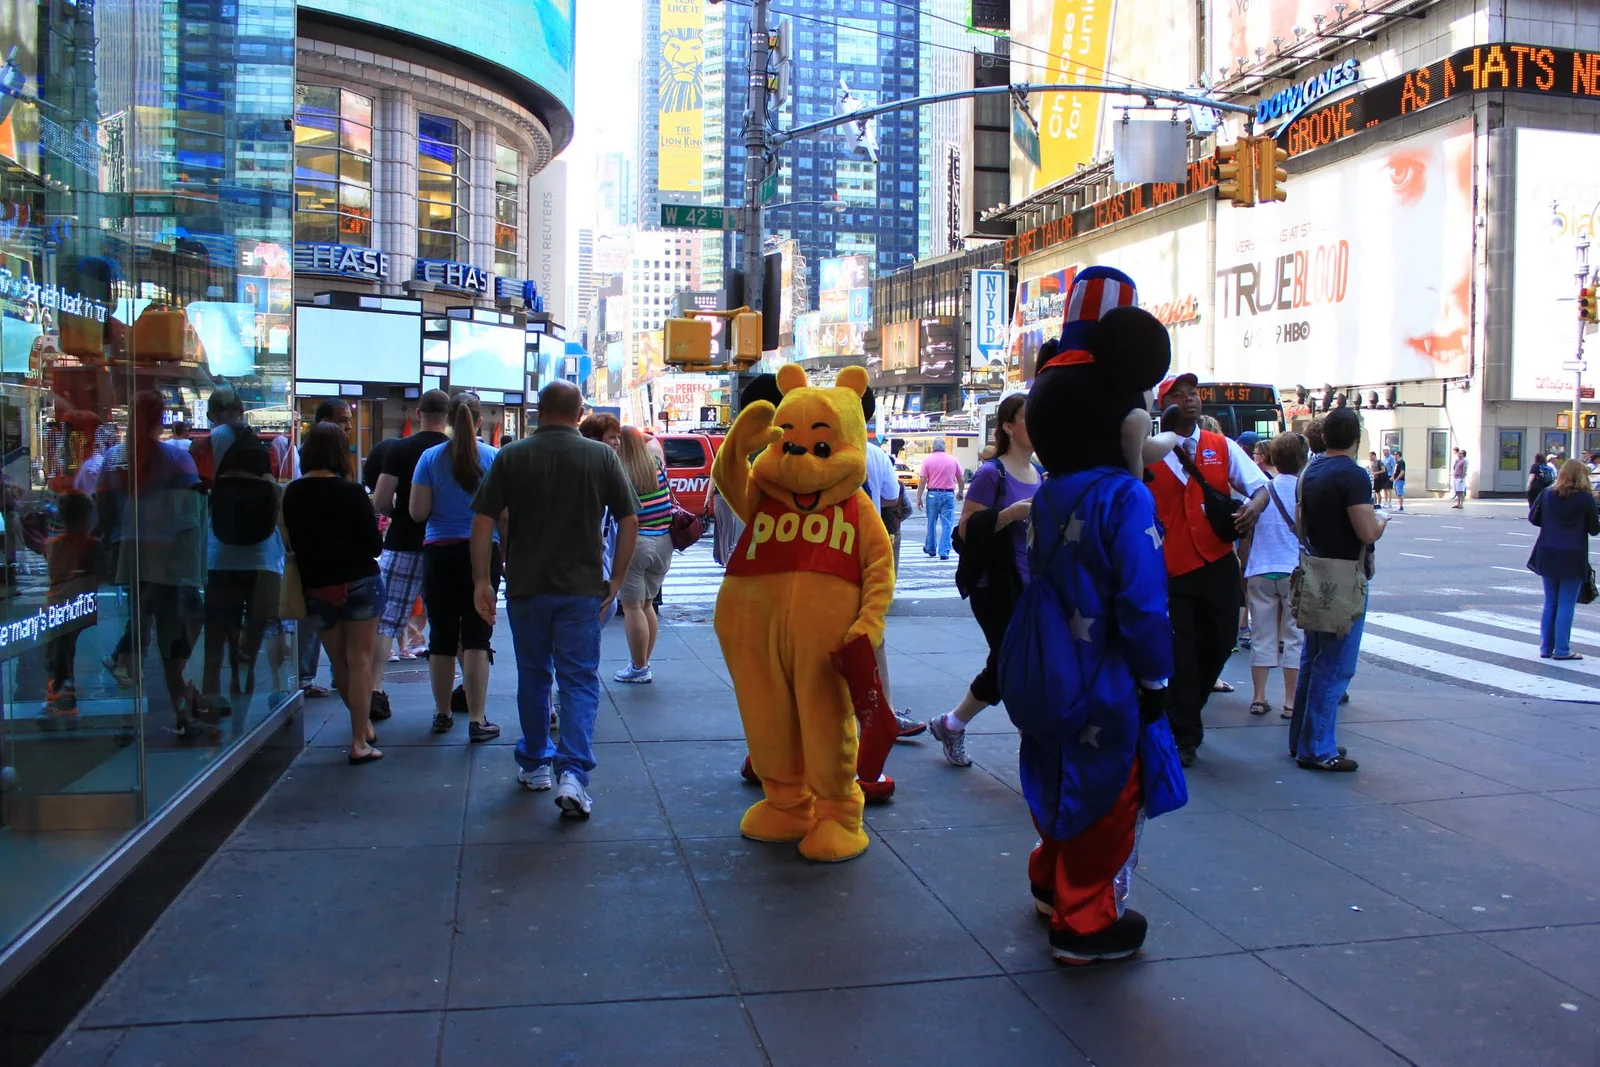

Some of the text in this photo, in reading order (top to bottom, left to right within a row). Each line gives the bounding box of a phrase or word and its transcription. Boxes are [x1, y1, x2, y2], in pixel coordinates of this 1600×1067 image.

[668, 5, 688, 13] LIKE
[1078, 0, 1096, 55] uni
[1401, 66, 1430, 115] AS
[661, 136, 682, 147] LION
[1018, 229, 1037, 257] BRET
[1041, 215, 1073, 249] TAYLOR
[1093, 195, 1125, 228] TEXAS
[1130, 188, 1145, 215] OIL
[1153, 180, 1178, 207] MAN
[1288, 98, 1356, 157] GROOVE
[542, 191, 552, 249] REUTERS
[665, 207, 723, 226] W 42 ST
[1217, 239, 1349, 319] TRUE BLOOD
[986, 276, 996, 343] NYPD
[1283, 321, 1310, 343] HBO
[1225, 388, 1235, 400] 41
[1239, 387, 1250, 400] ST
[669, 478, 710, 492] FDNY
[746, 505, 856, 560] pooh
[0, 607, 47, 647] ermany's
